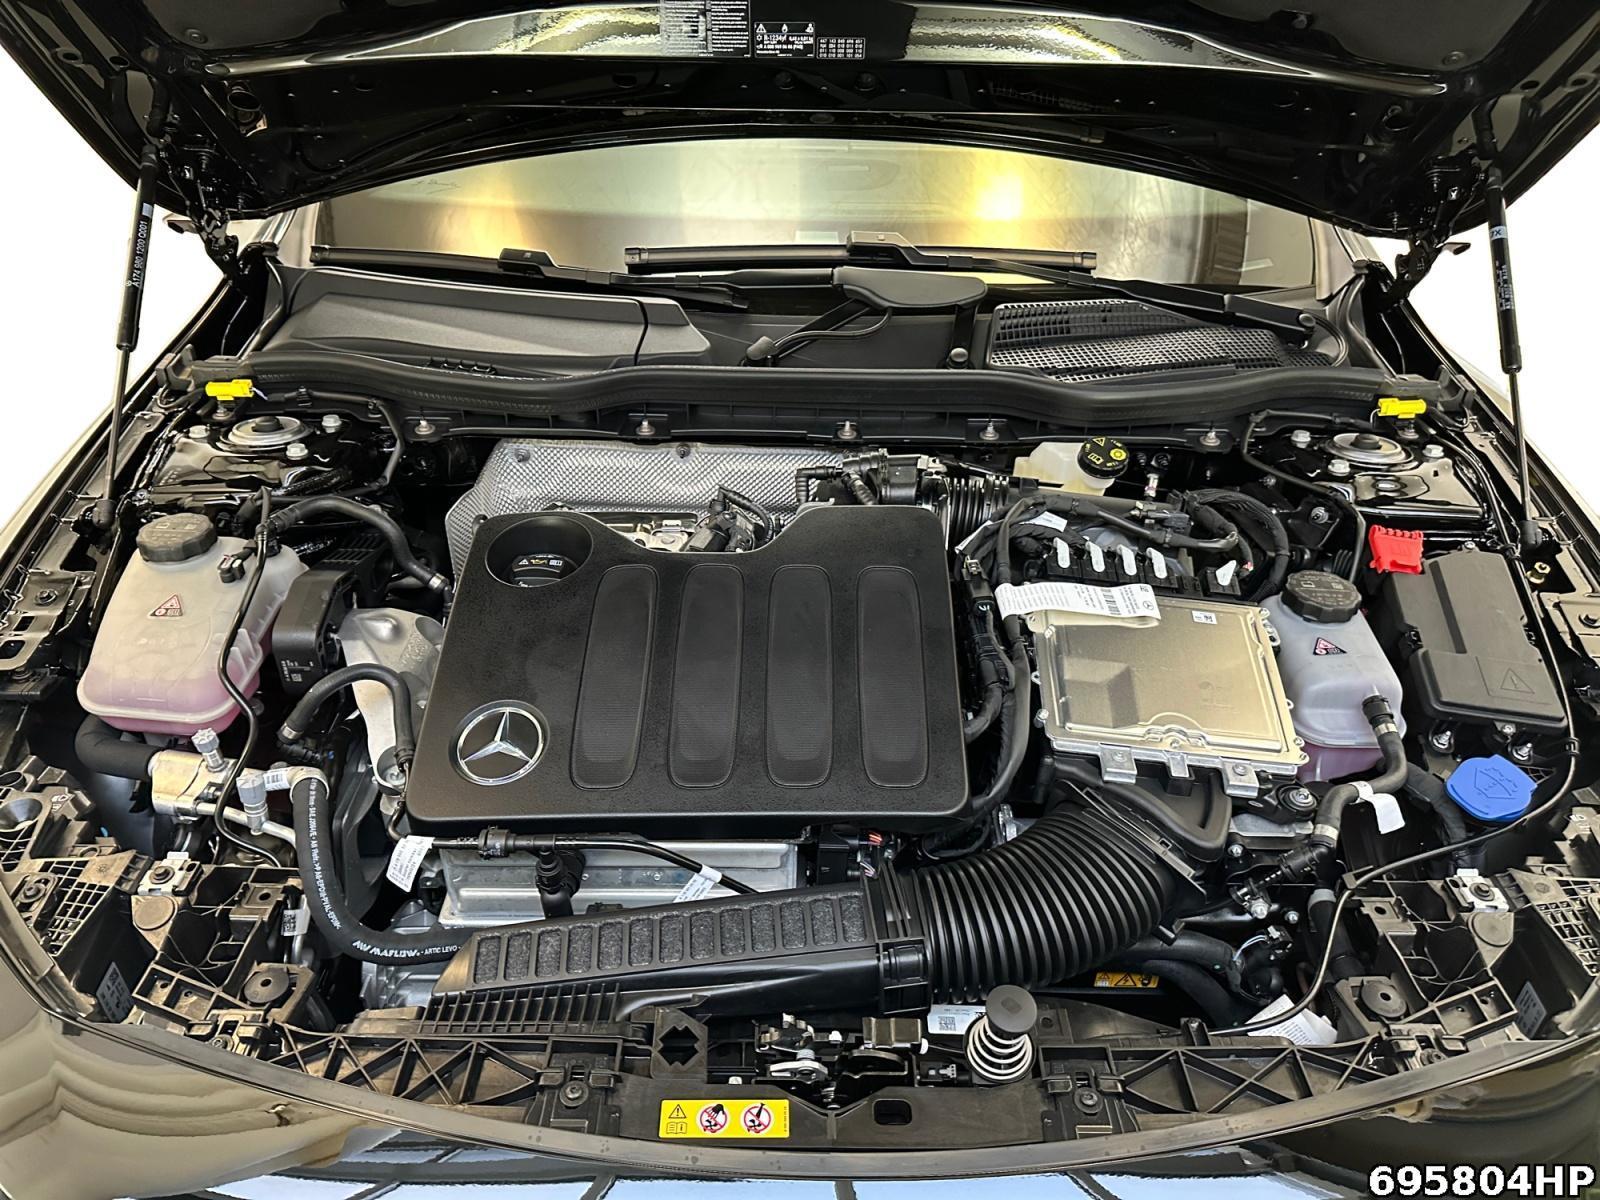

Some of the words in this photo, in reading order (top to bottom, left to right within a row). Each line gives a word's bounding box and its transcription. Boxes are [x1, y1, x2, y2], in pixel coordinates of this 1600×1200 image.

[136, 239, 146, 255] 1200
[132, 269, 141, 288] A174
[442, 946, 458, 954] LEVO
